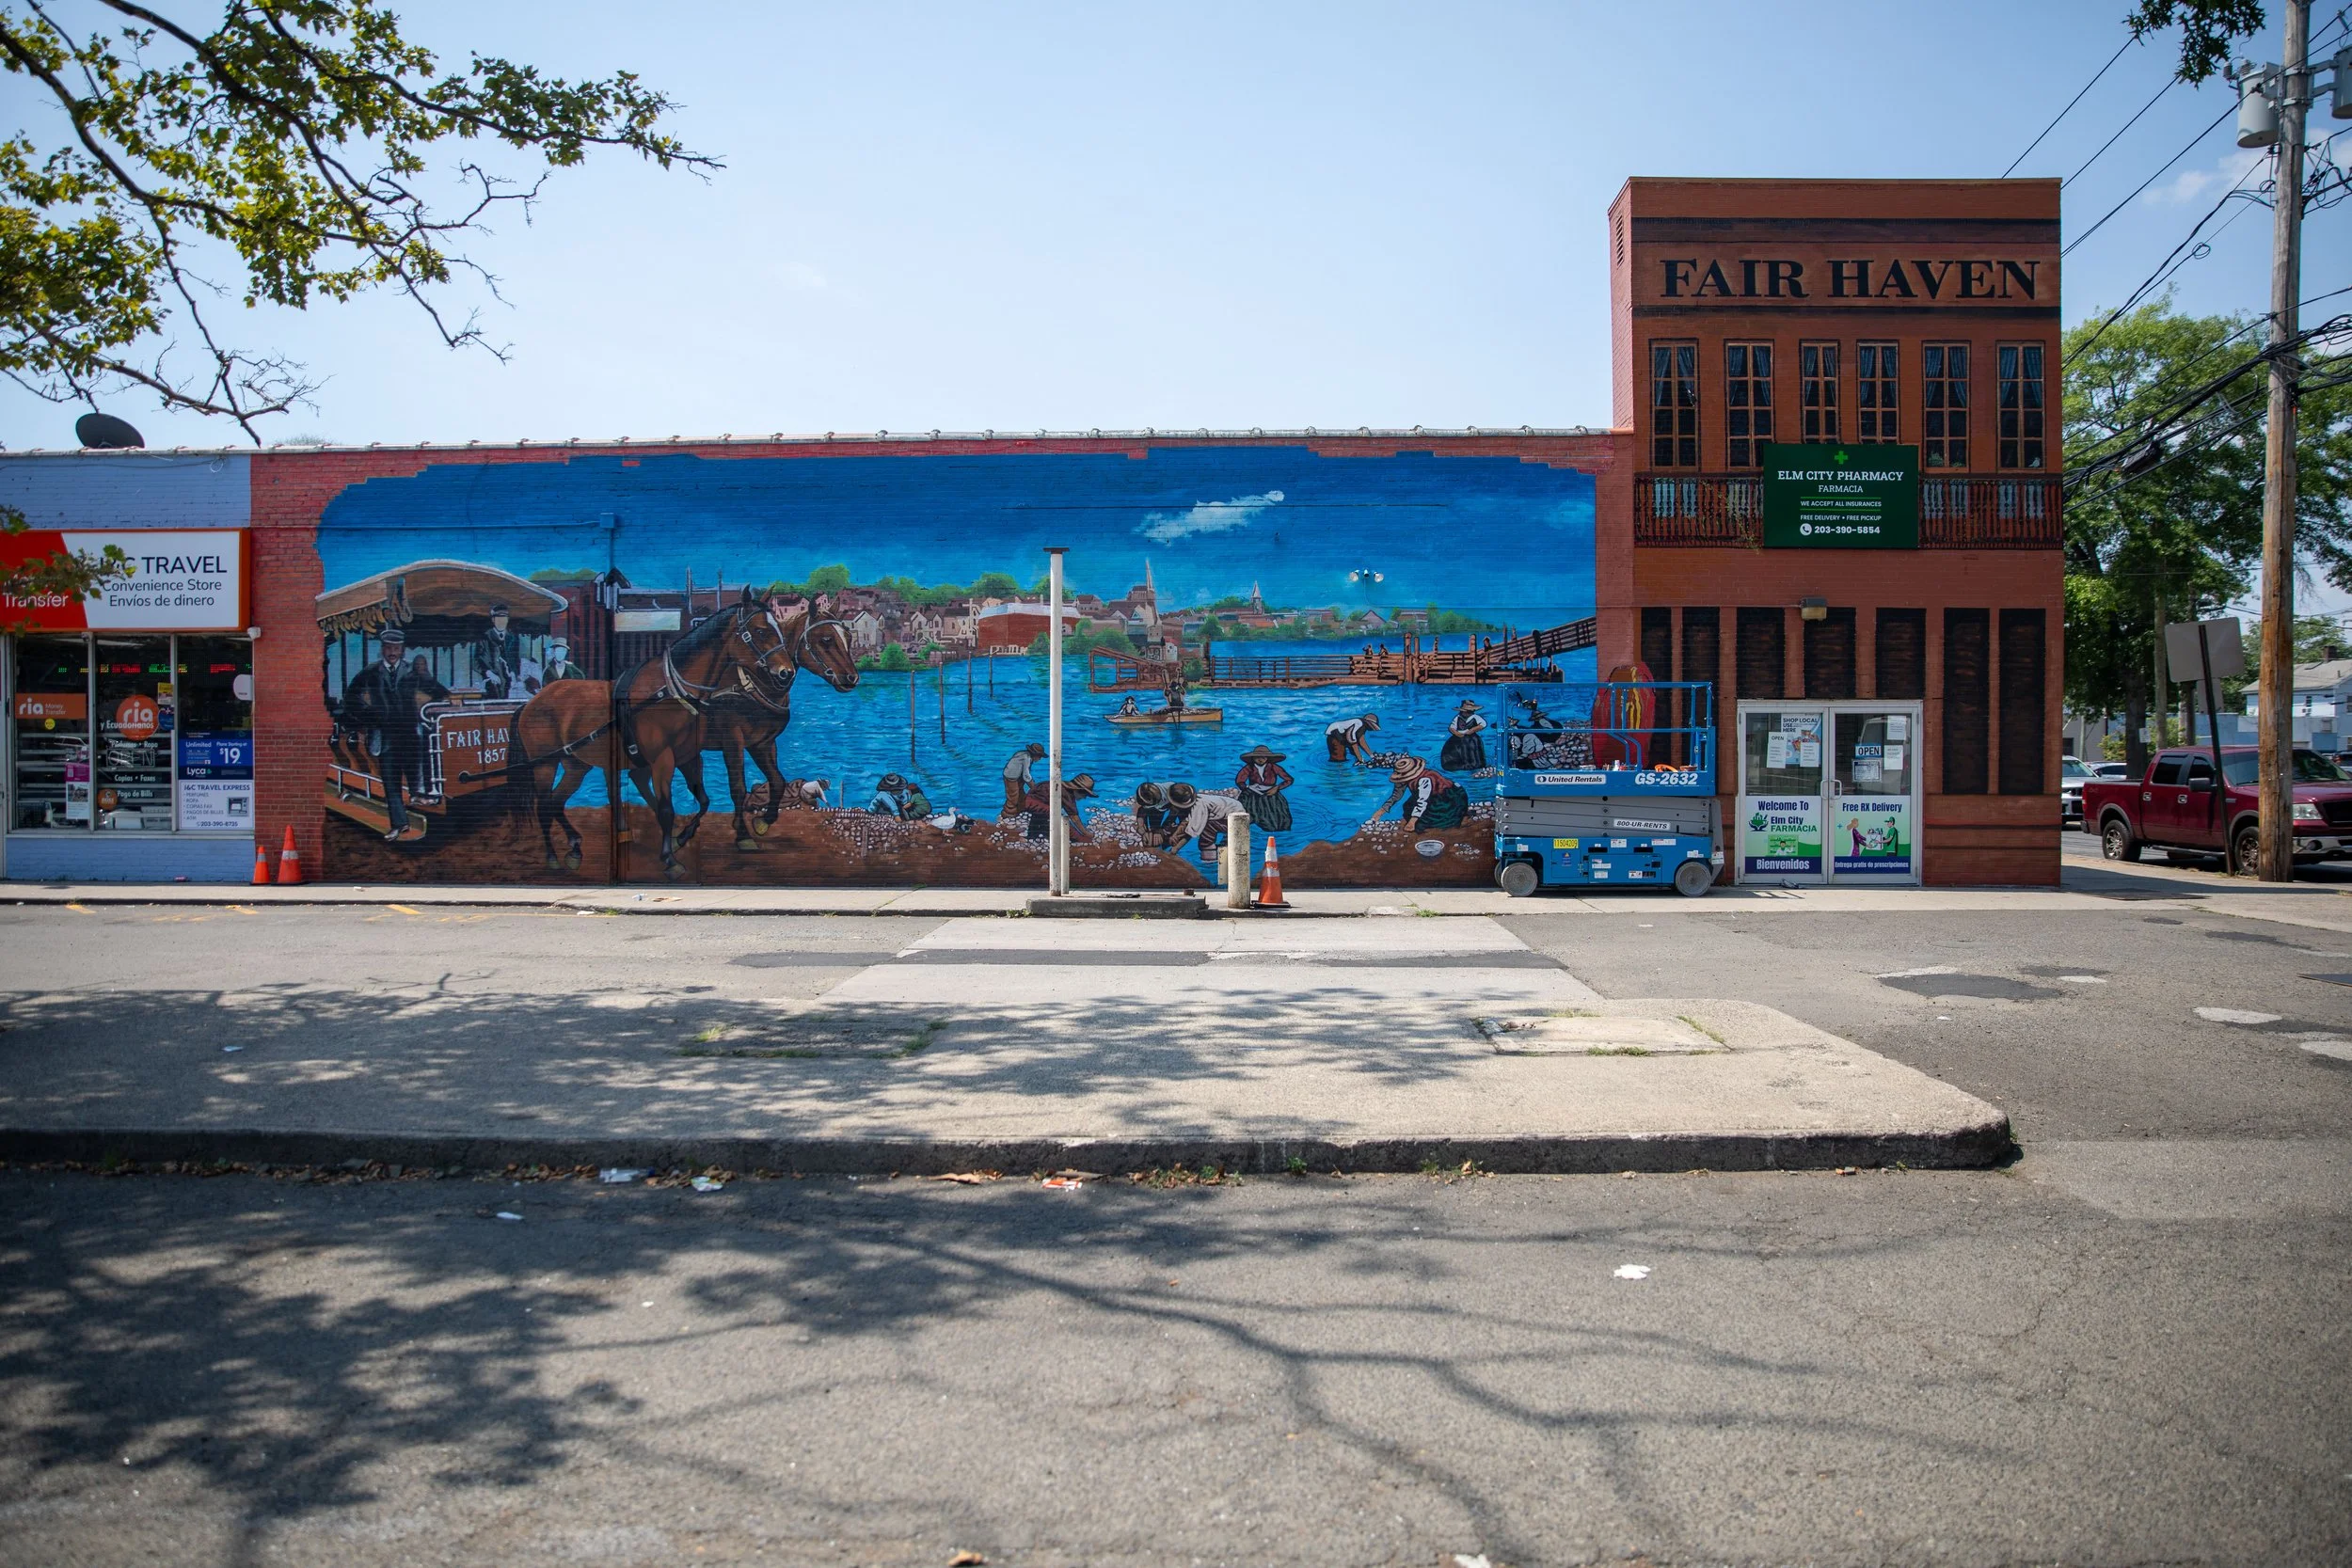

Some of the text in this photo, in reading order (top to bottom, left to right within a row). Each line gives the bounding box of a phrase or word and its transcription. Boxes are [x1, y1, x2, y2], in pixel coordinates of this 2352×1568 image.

[1660, 258, 2041, 300] FAIR HAVEN
[1777, 470, 1904, 482] ELM CITY PHARMACY
[1818, 484, 1864, 493] FARMACIA
[1814, 525, 1881, 534] 203-390-5854
[141, 556, 228, 574] TRAVEL
[103, 578, 222, 592] Convenience Store
[2, 591, 69, 608] Transfer
[109, 594, 215, 607] Envíos de dinero
[19, 697, 43, 715] ria
[123, 701, 153, 723] ria
[100, 721, 105, 731] y
[446, 729, 482, 749] FAIR
[219, 747, 241, 764] $19
[477, 748, 506, 764] 1857
[1858, 746, 1880, 755] OPEN
[186, 768, 206, 776] Lyca
[114, 774, 133, 783] Copias
[1634, 772, 1698, 785] GS-2632
[1757, 800, 1809, 811] Welcome To
[1842, 802, 1902, 813] Free RX Delivery
[1616, 820, 1668, 830] 800-UR-RENTS
[1788, 816, 1804, 825] City
[1756, 859, 1810, 870] Bienvenidos
